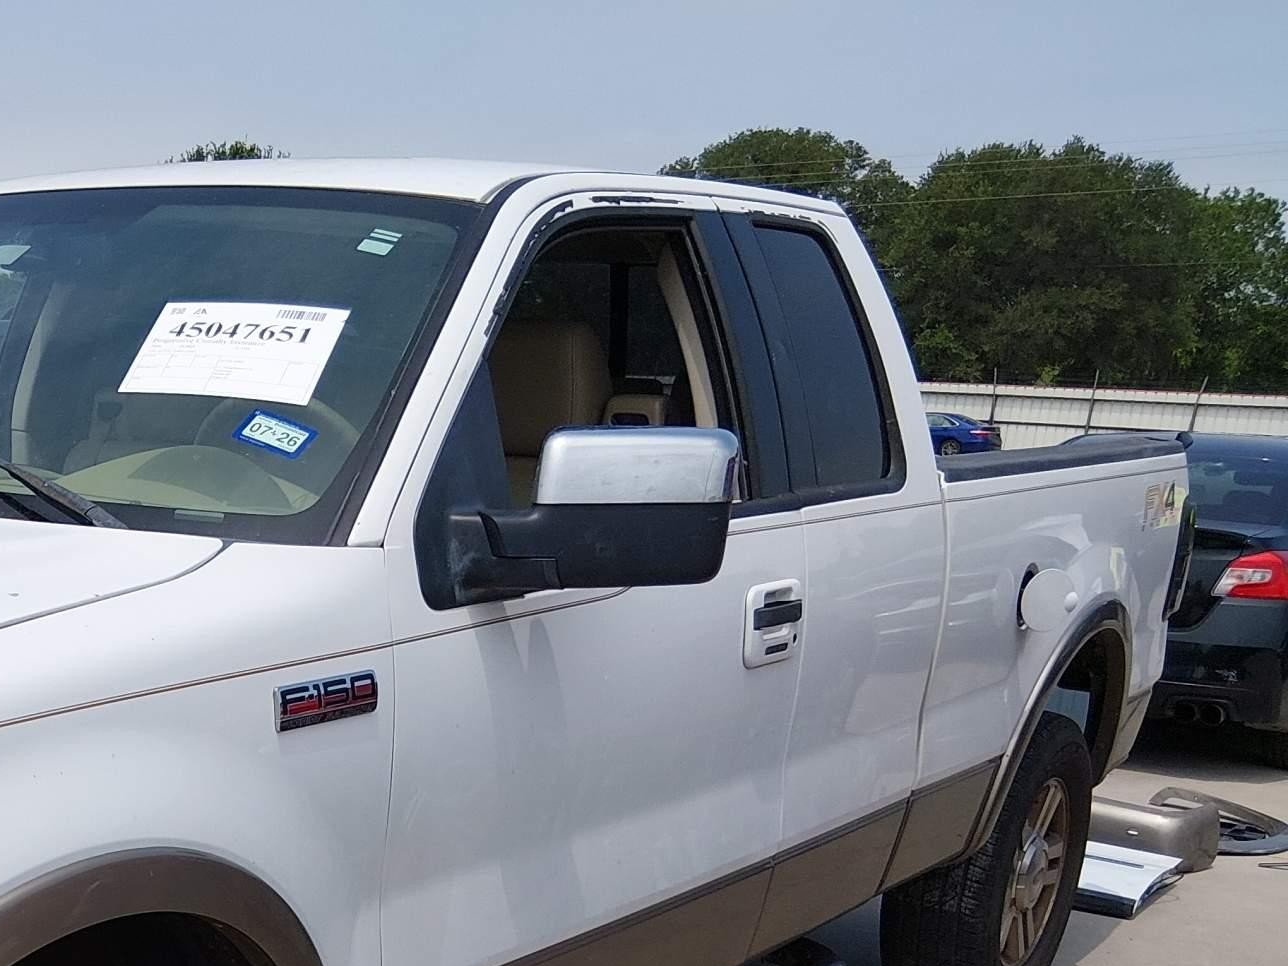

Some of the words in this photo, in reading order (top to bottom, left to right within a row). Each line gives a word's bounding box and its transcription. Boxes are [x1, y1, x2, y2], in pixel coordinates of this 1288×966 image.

[169, 321, 312, 344] 45047651
[249, 422, 274, 436] 07
[275, 431, 301, 447] 26
